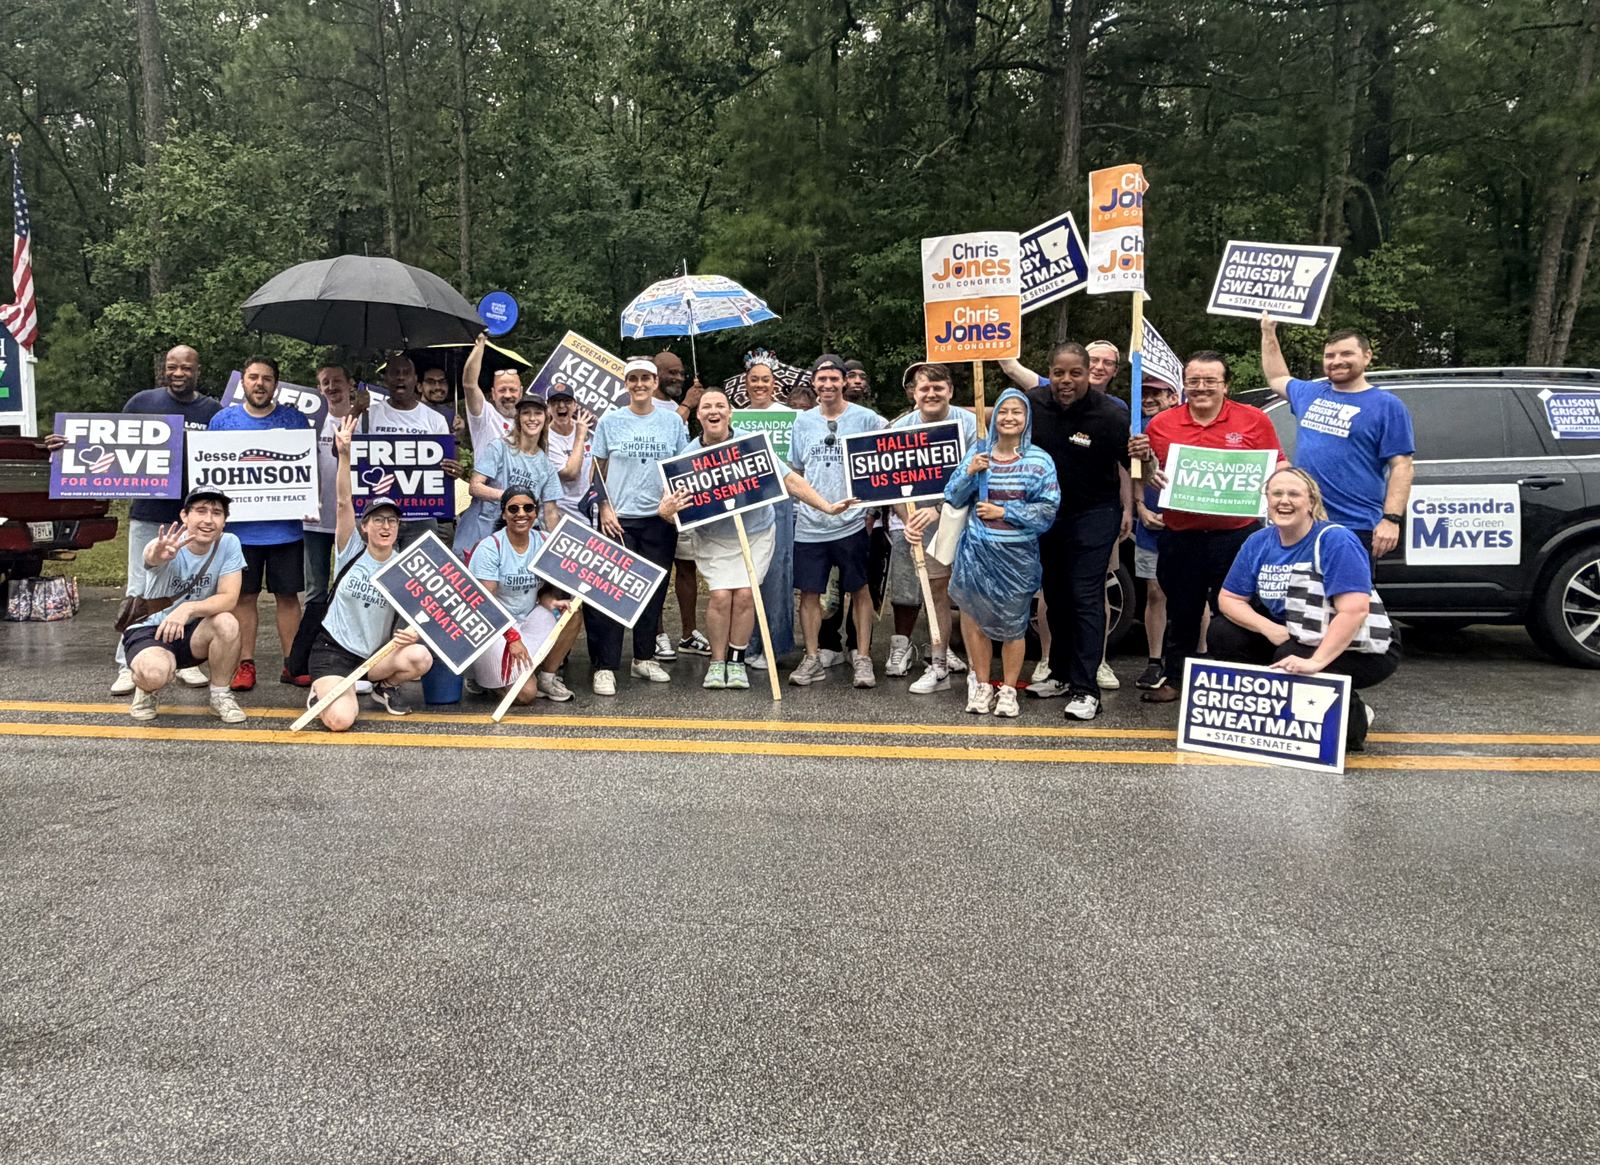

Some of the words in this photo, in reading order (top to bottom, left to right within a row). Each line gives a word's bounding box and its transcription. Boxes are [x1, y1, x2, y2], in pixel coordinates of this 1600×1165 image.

[1097, 211, 1118, 221] FOR
[952, 241, 999, 261] Chris
[1229, 250, 1296, 269] ALLISON
[931, 258, 1011, 281] Jones
[1020, 256, 1074, 290] ATMAN
[1097, 273, 1116, 282] FOR
[1225, 264, 1292, 283] GRIGSBY
[956, 278, 1012, 288] CONGRESS
[1029, 281, 1059, 298] SENATE
[1220, 279, 1310, 301] SWEATMAN
[1234, 297, 1256, 306] STATE
[1258, 299, 1287, 310] SENATE
[953, 304, 1000, 324] Chris
[934, 321, 1011, 343] Jones
[570, 339, 611, 368] SECRETARY
[610, 362, 623, 372] OF
[934, 344, 952, 352] FOR
[957, 341, 1012, 351] CONGRESS
[558, 353, 627, 402] KELLY
[1549, 399, 1596, 408] ALLISON
[1550, 407, 1596, 416] GRIGSBY
[731, 420, 793, 430] CASSANDRA
[1303, 411, 1352, 429] SWEATMAN
[1553, 416, 1600, 425] SWEATM
[64, 419, 171, 445] FRED
[623, 443, 667, 451] SHOFFNER
[876, 432, 929, 453] HALLIE
[194, 451, 237, 462] Jesse
[350, 440, 444, 466] FRED
[691, 446, 741, 471] HALLIE
[855, 445, 956, 474] SHOFFNER
[195, 465, 312, 486] JOHNSON
[512, 467, 532, 479] HALLIE
[675, 454, 769, 495] SHOFFNER
[1179, 458, 1263, 474] CASSANDRA
[61, 477, 87, 486] FOR
[93, 477, 169, 487] GOVERNOR
[870, 474, 889, 488] US
[892, 466, 943, 485] SENATE
[1176, 469, 1262, 492] MAYES
[694, 492, 711, 506] US
[712, 475, 760, 499] SENATE
[395, 498, 445, 506] VERNOR
[1197, 496, 1257, 506] REPRESENTATIVE
[1412, 498, 1515, 515] Cassandra
[1412, 517, 1514, 549] MAYES
[1454, 518, 1470, 528] Go
[1472, 518, 1505, 528] Green
[585, 536, 634, 571] HALLIE
[556, 537, 645, 597] SHOFFNER
[348, 579, 384, 597] SHOFF
[439, 562, 485, 609] HALLIE
[560, 559, 578, 574] US
[578, 568, 624, 602] SENATE
[1257, 581, 1289, 590] SWEAT
[351, 591, 361, 599] US
[406, 555, 490, 641] SHOFFNER
[404, 578, 424, 598] US
[420, 595, 463, 641] SENATE
[1194, 671, 1289, 698] ALLISON
[1192, 689, 1287, 716] GRIGSBY
[1190, 707, 1322, 741] SWEATMAN
[1214, 732, 1246, 744] STATE
[1250, 737, 1292, 751] SENATE
